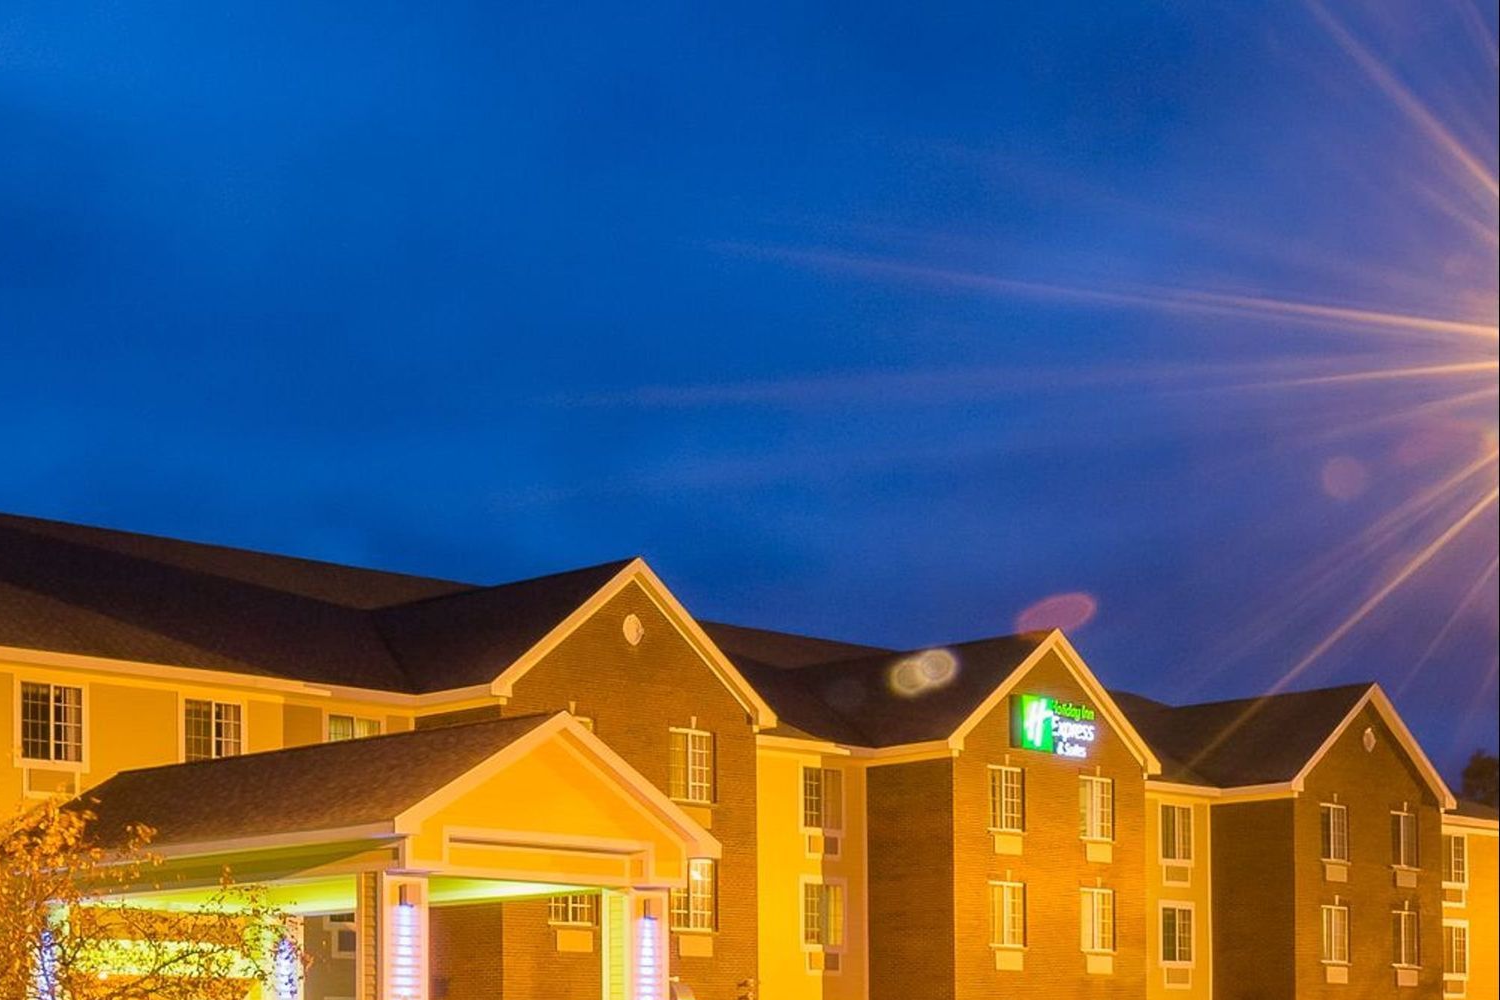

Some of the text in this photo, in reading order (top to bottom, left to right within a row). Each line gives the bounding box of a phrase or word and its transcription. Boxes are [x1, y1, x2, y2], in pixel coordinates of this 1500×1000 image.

[1051, 699, 1095, 721] Holiday Inn
[1052, 715, 1095, 742] Express
